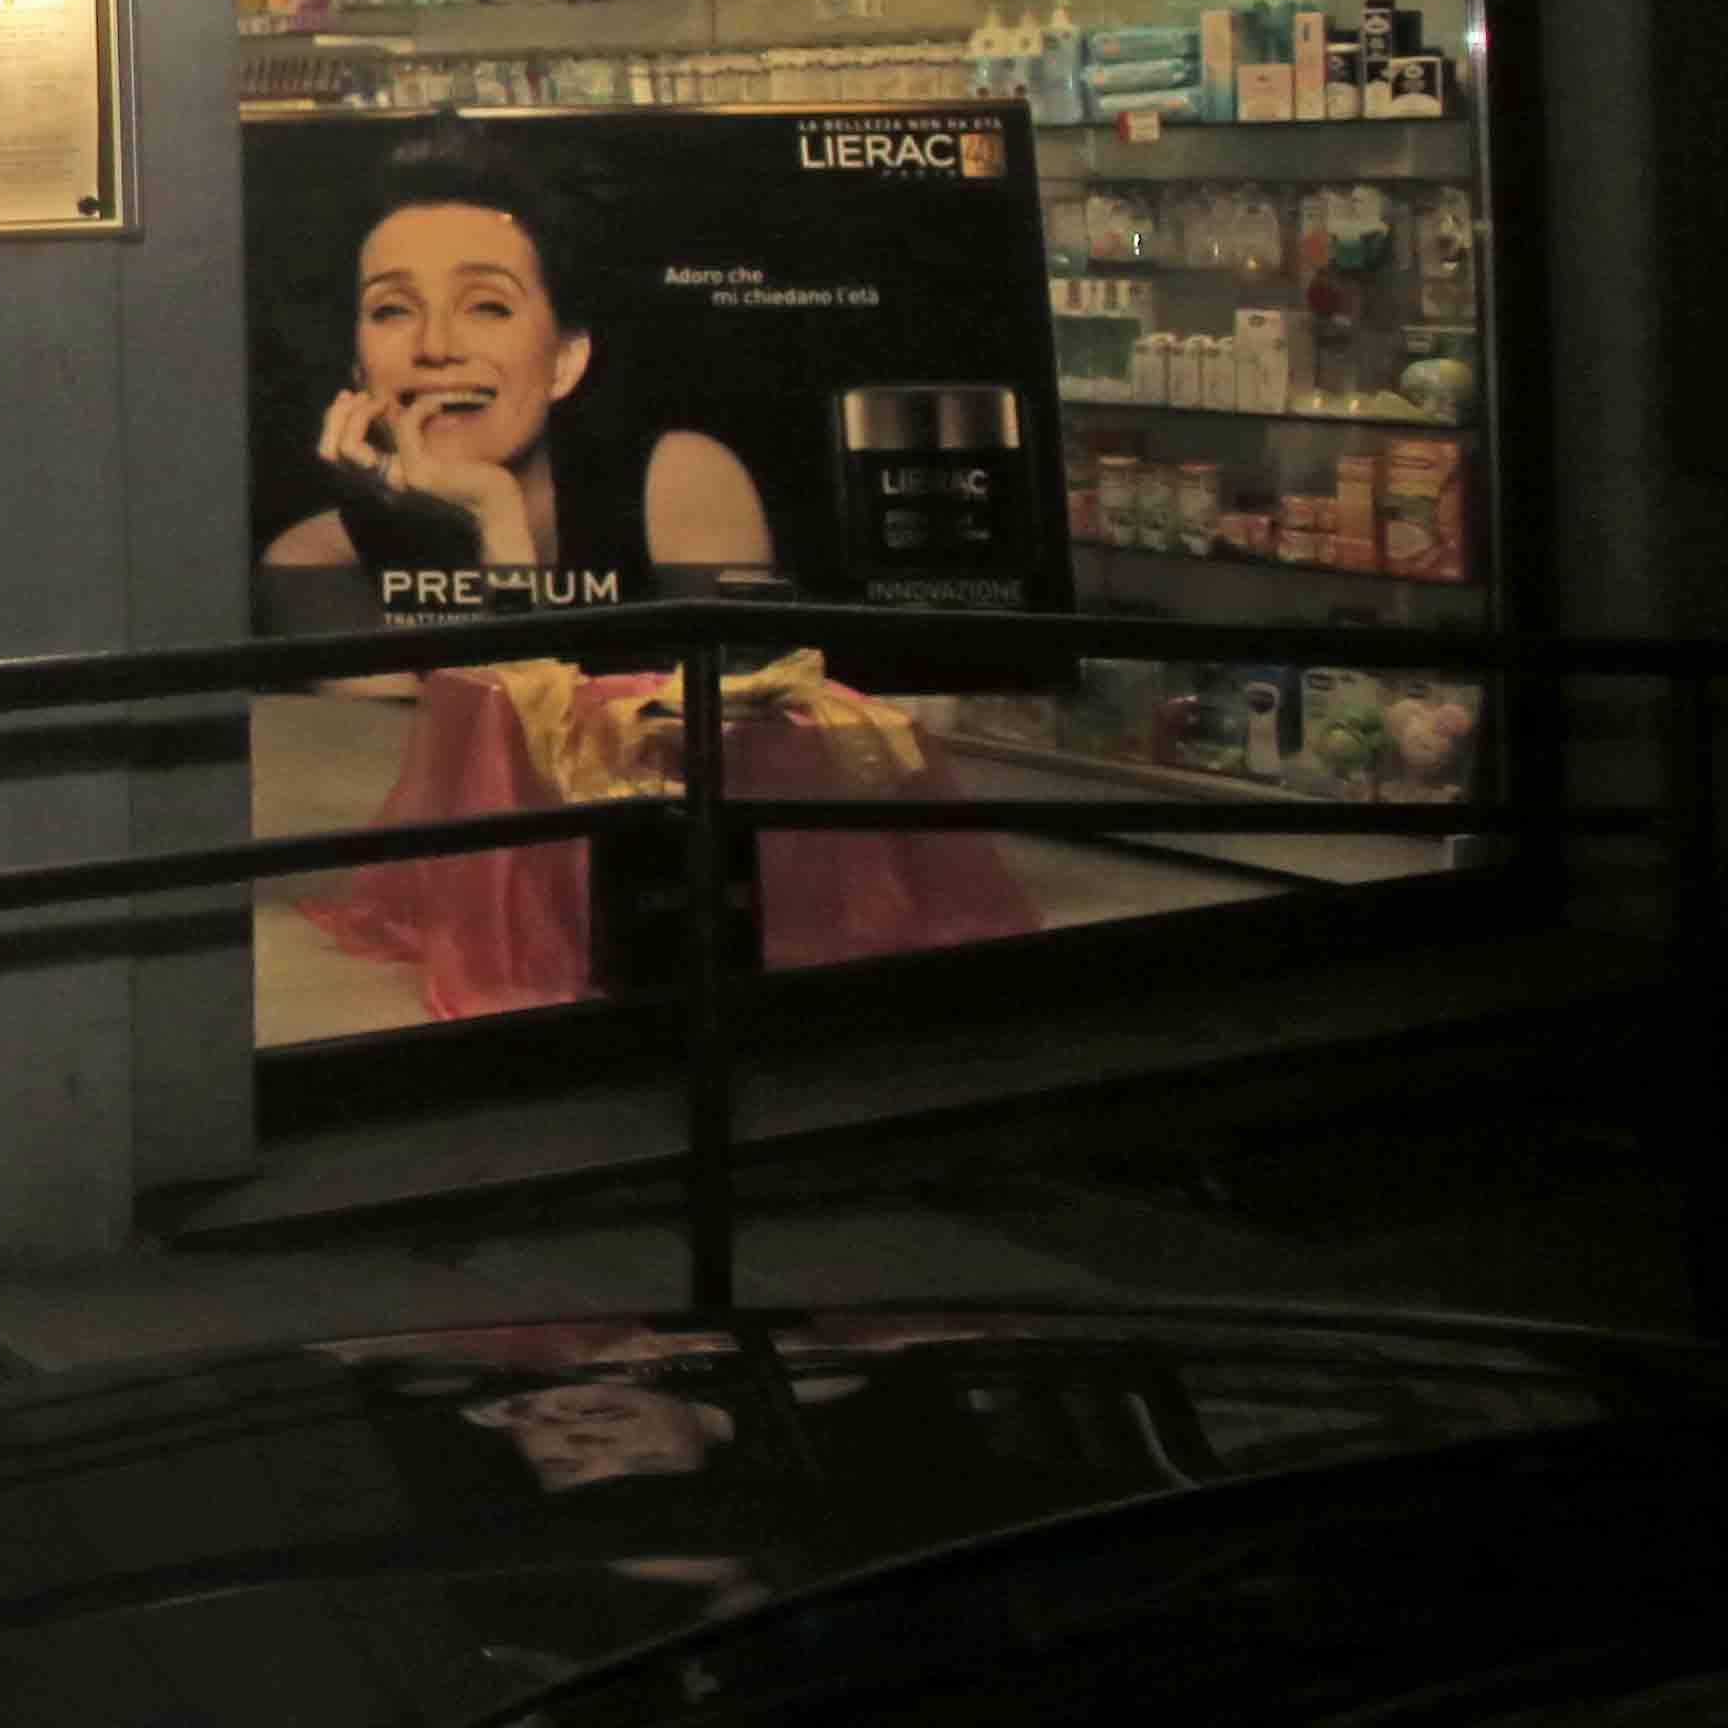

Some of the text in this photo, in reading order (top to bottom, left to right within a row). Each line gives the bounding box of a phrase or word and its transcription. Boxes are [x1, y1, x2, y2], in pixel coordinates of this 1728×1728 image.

[800, 134, 956, 168] LIERAC
[664, 267, 764, 284] Adoro che
[712, 289, 737, 304] mi
[744, 287, 832, 304] chiedano
